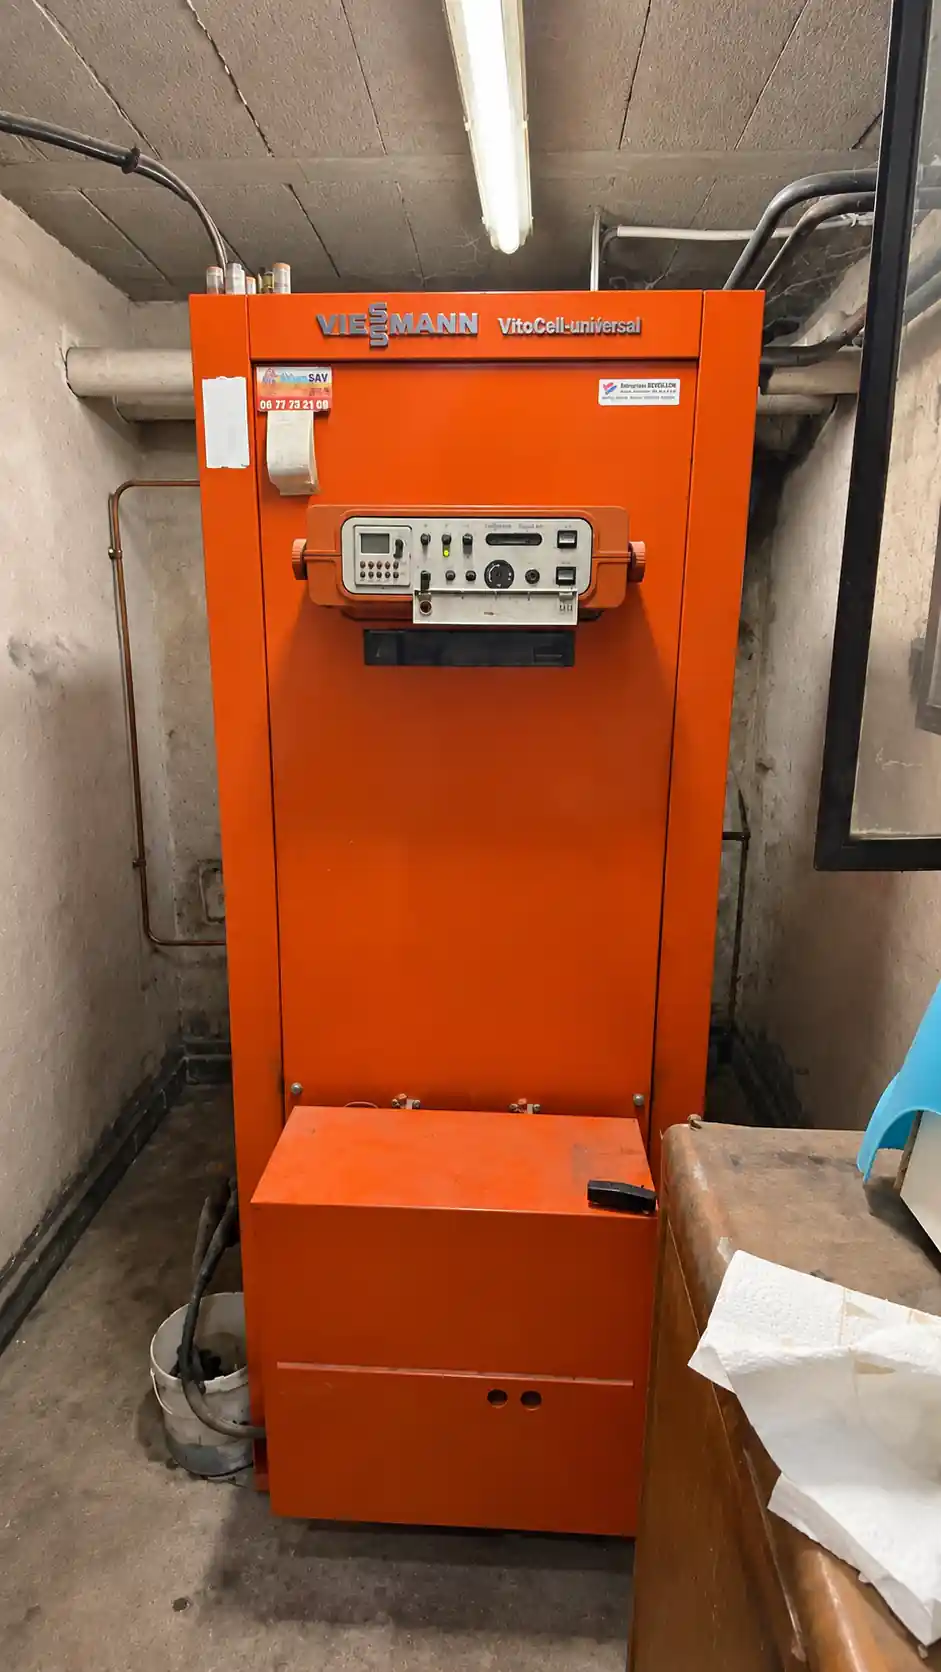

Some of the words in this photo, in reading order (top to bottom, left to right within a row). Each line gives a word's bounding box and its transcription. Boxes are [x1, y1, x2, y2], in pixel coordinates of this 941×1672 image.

[499, 316, 642, 335] VitoCell-universal
[308, 373, 328, 382] SAV
[260, 400, 272, 409] 06
[275, 400, 286, 409] 77
[302, 400, 314, 409] 21
